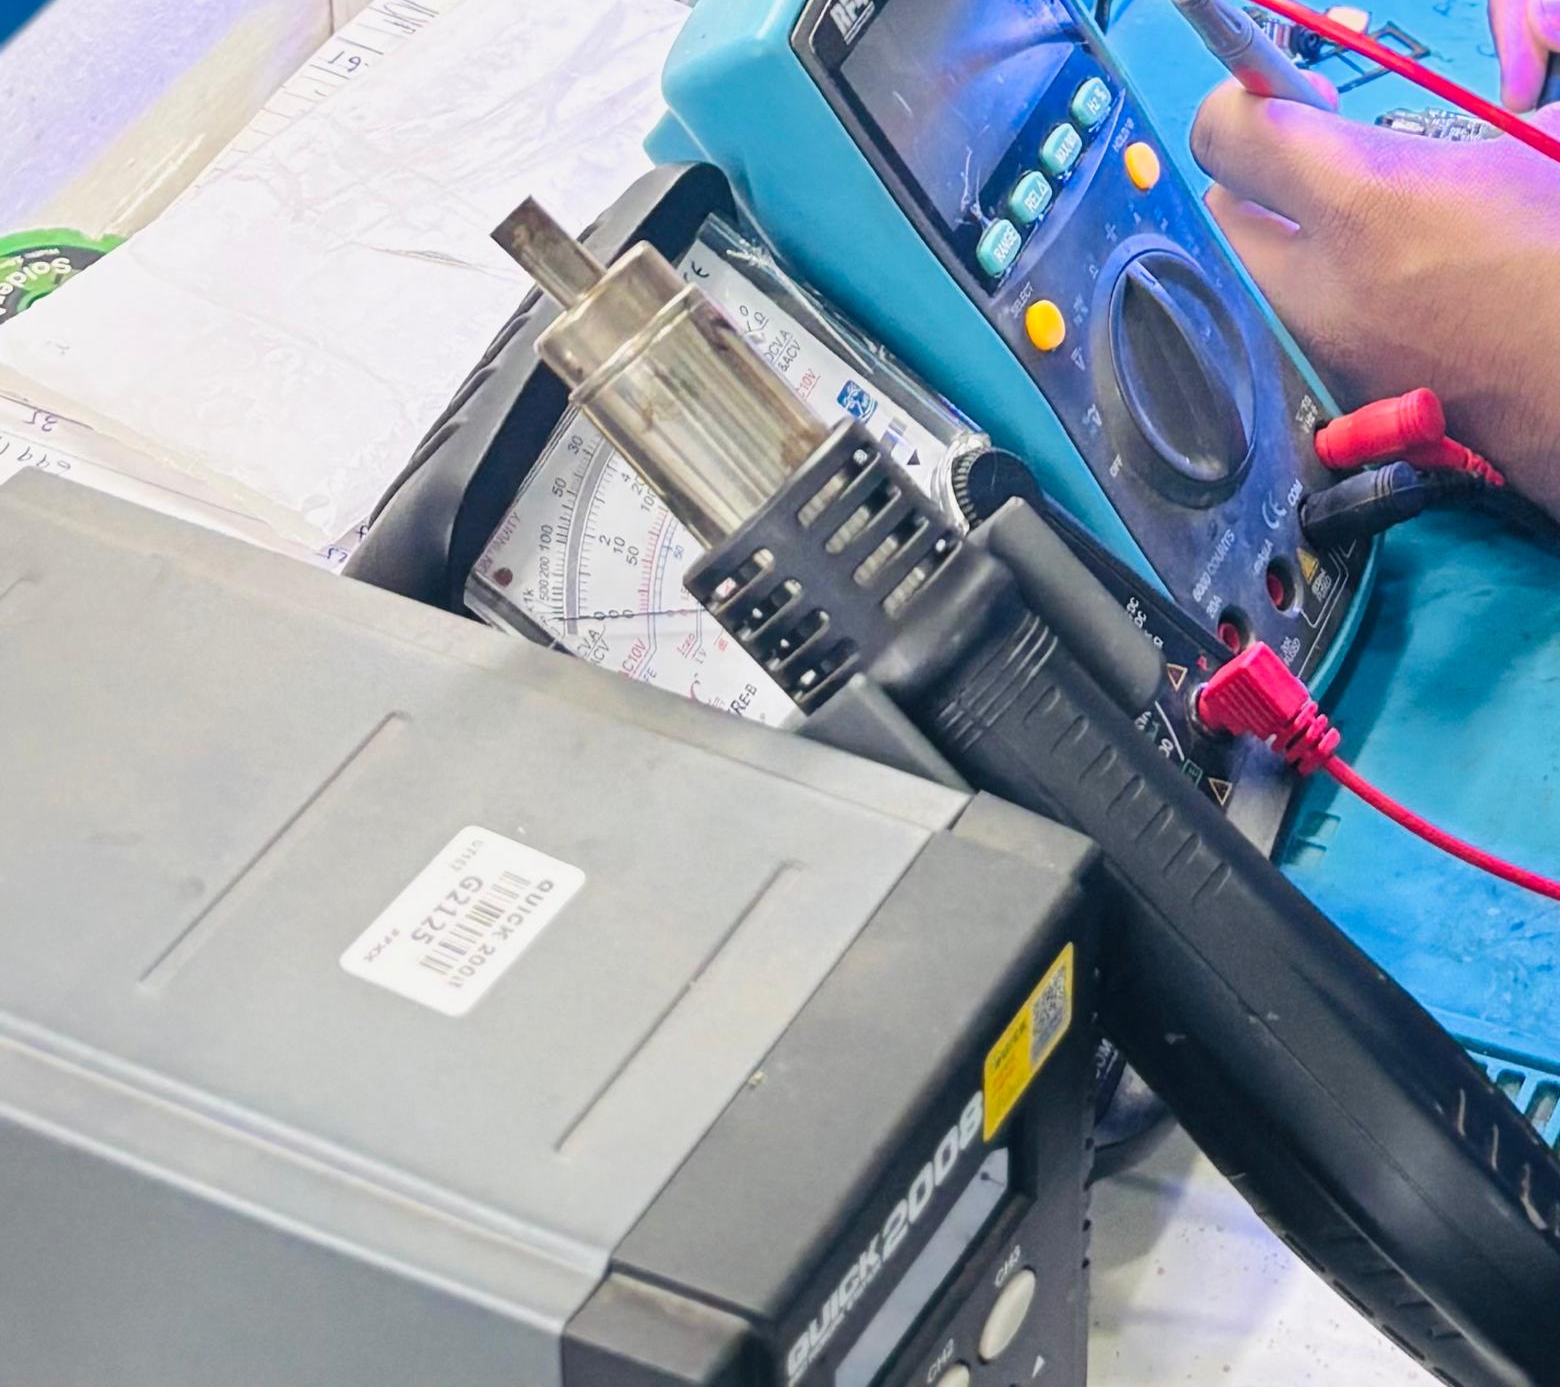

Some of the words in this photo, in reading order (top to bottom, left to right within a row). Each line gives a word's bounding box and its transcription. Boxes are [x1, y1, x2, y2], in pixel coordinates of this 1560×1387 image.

[993, 225, 1020, 264] RANGE
[0, 257, 72, 305] Solde
[1010, 282, 1035, 318] SELECT
[567, 435, 584, 455] 30
[551, 477, 567, 498] 50
[538, 524, 554, 552] 100
[598, 534, 612, 547] 2
[612, 536, 626, 555] 10
[539, 556, 551, 578] 200
[625, 546, 641, 567] 50
[1207, 529, 1235, 577] COUNTS
[539, 579, 550, 602] 500
[728, 683, 758, 715] RE-B
[410, 875, 484, 946] G2125
[492, 879, 555, 941] QUICK
